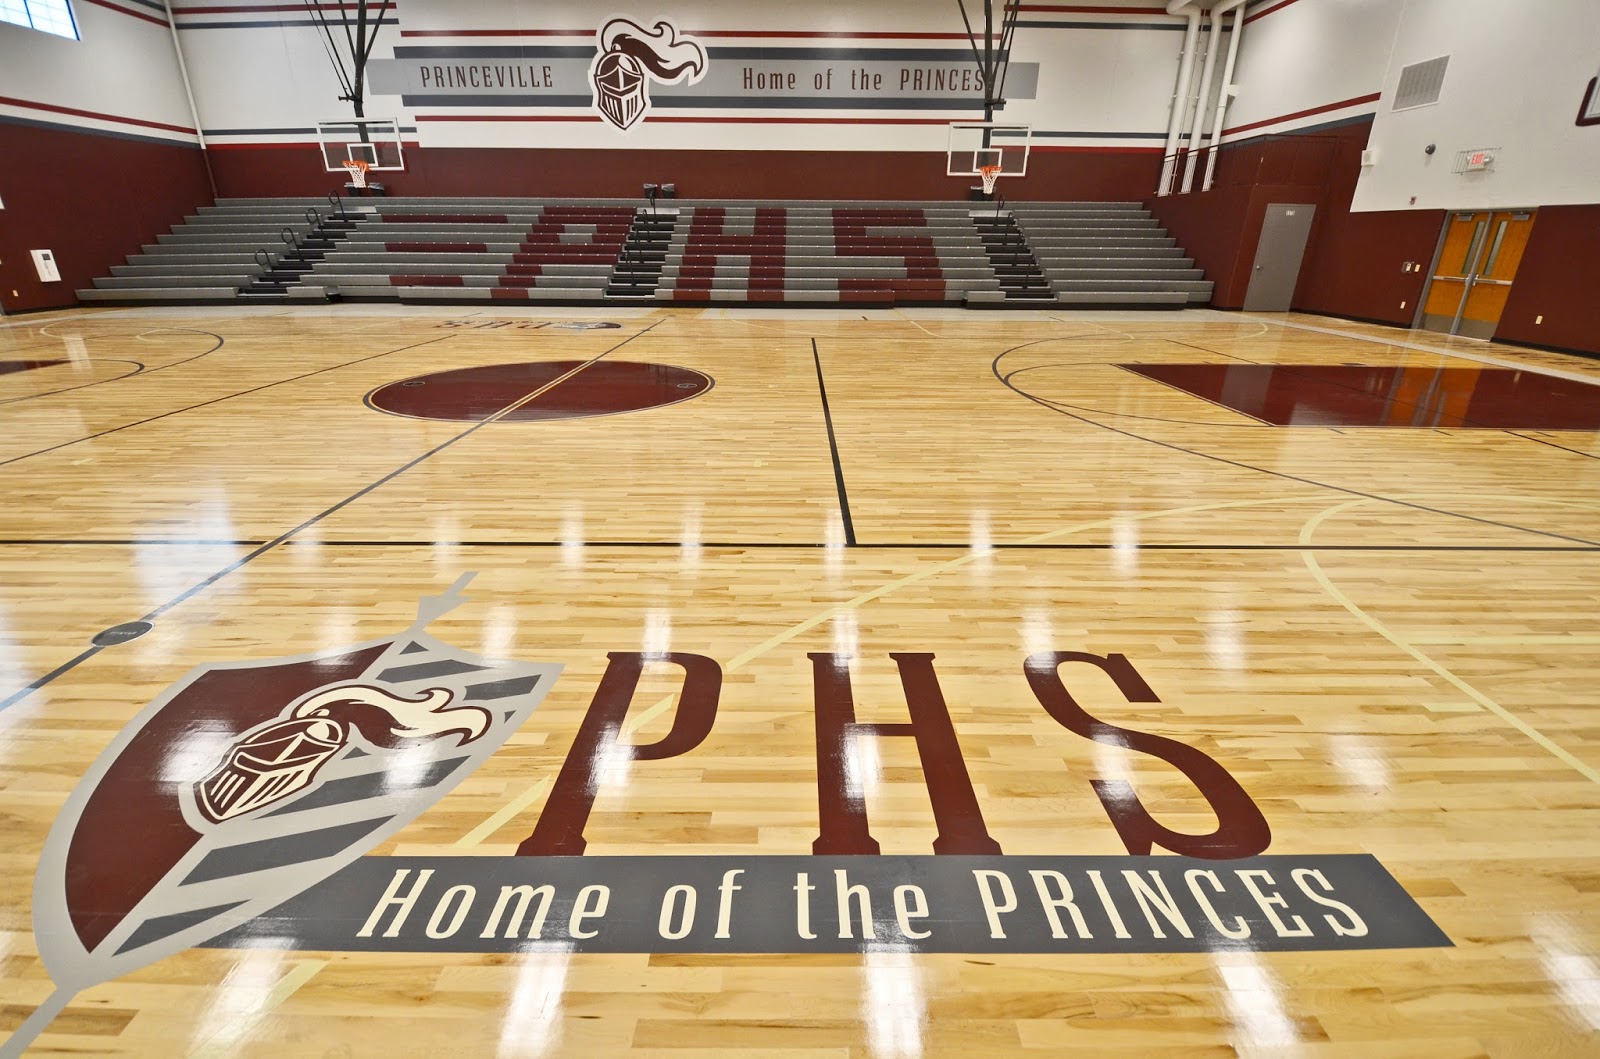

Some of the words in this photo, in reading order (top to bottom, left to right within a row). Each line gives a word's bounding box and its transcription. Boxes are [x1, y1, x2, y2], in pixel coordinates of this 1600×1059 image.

[419, 65, 553, 88] PRINCEVILLE
[743, 67, 796, 90] Home
[814, 68, 833, 91] of
[851, 69, 882, 91] the
[899, 69, 984, 91] PRINCES
[515, 650, 1272, 860] PHS
[356, 869, 611, 940] Home
[657, 869, 745, 940] of
[793, 869, 933, 941] the
[972, 868, 1369, 940] PRINCES
